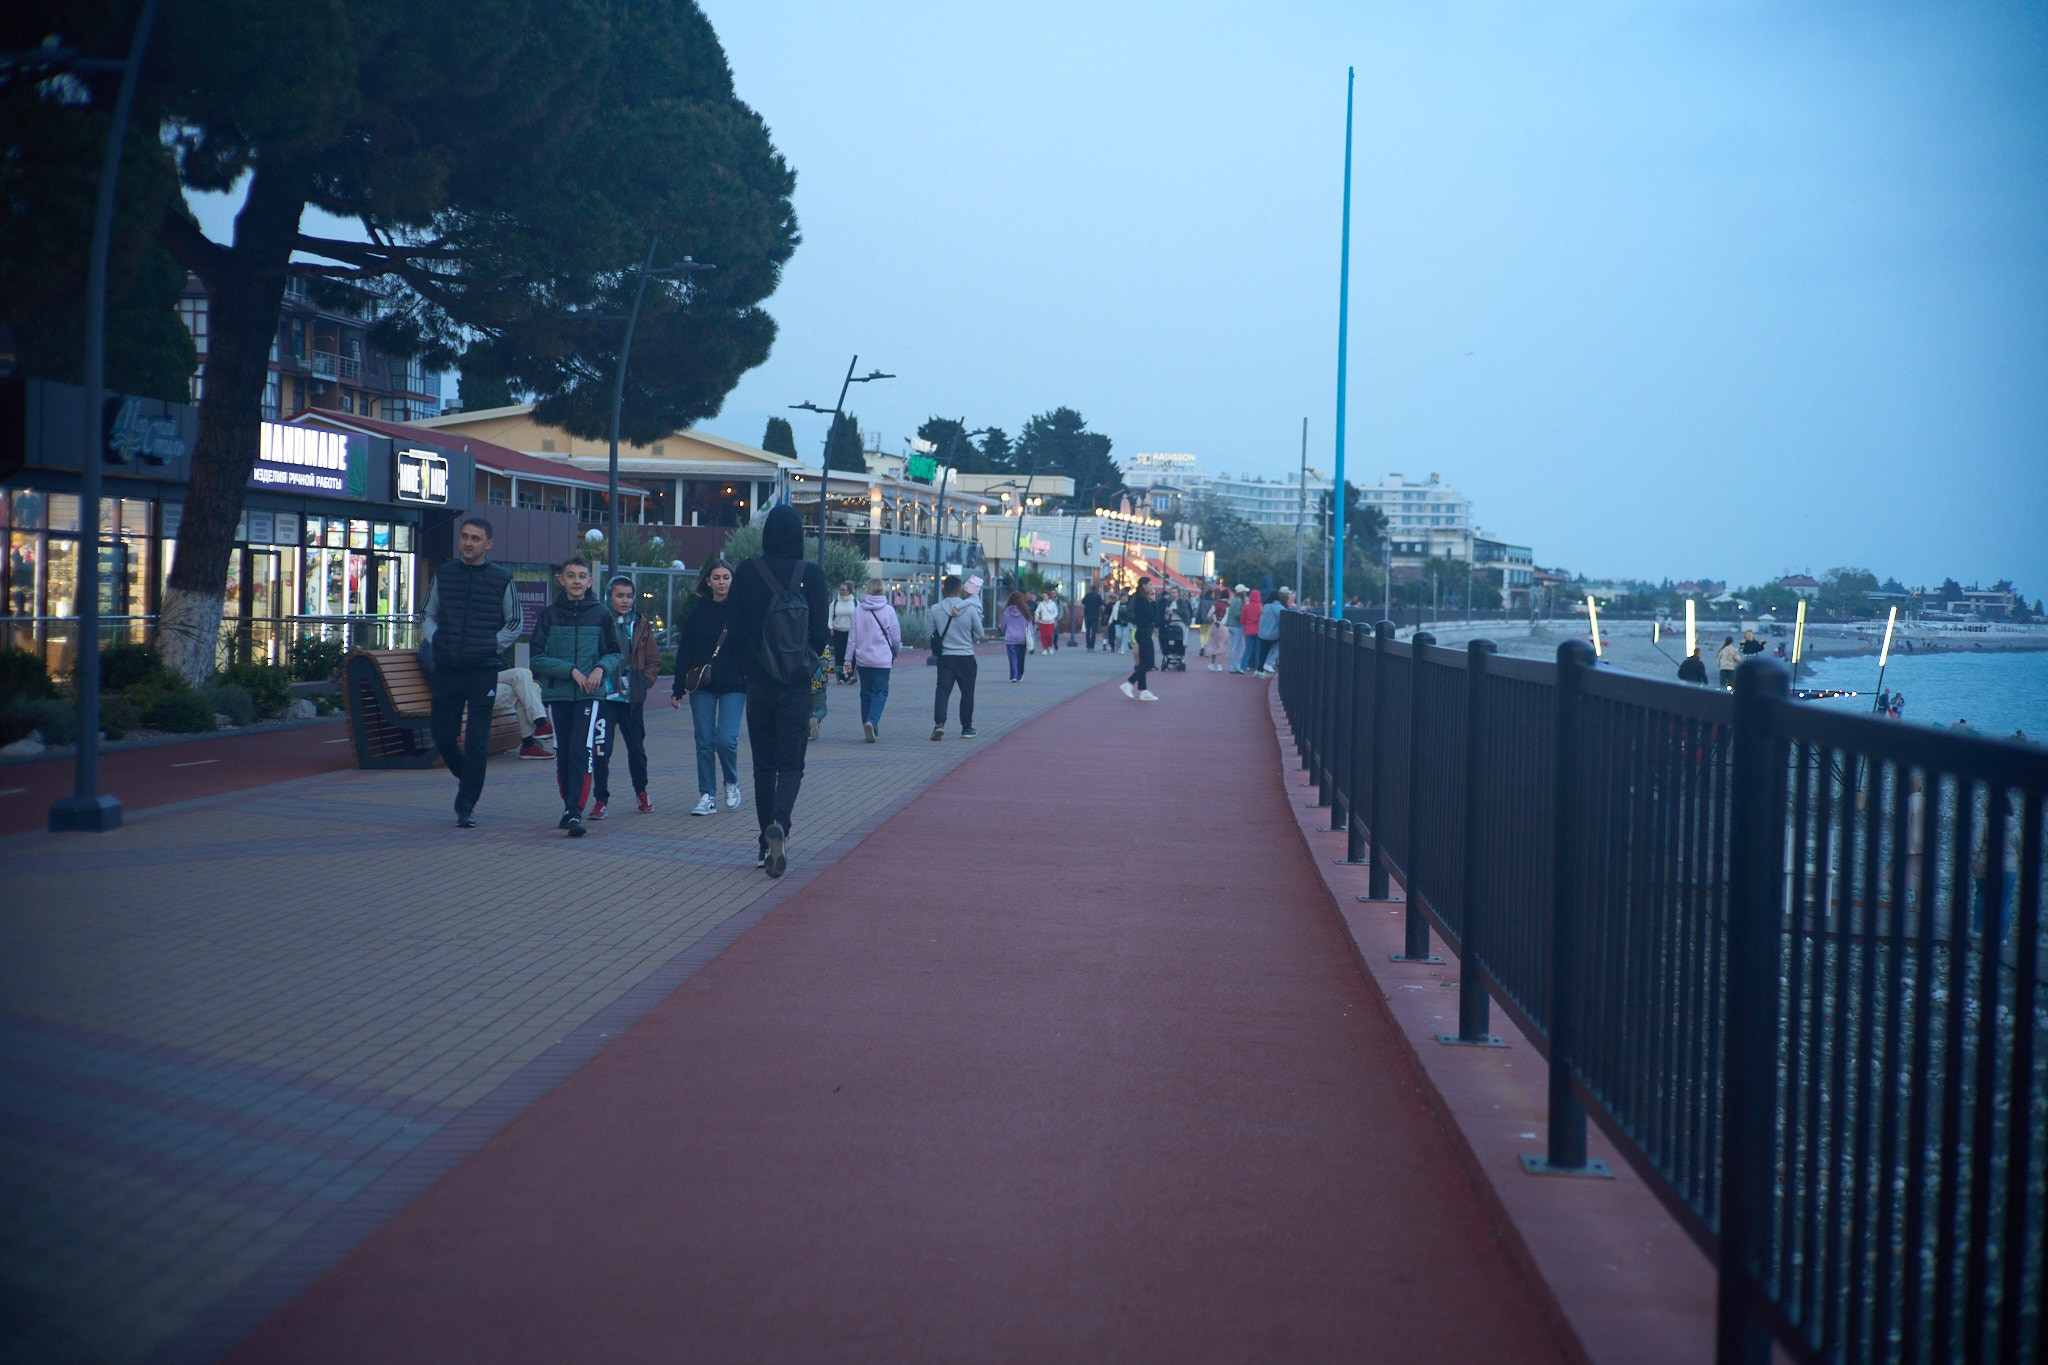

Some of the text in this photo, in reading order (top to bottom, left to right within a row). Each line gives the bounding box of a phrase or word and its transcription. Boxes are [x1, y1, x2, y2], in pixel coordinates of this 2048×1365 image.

[260, 421, 347, 471] HANDMADE
[253, 468, 342, 490] ИЗДЕЛИЯ РУЧНОЙ РАБОТЫ
[517, 592, 545, 602] DMADE
[594, 718, 606, 757] FILA
